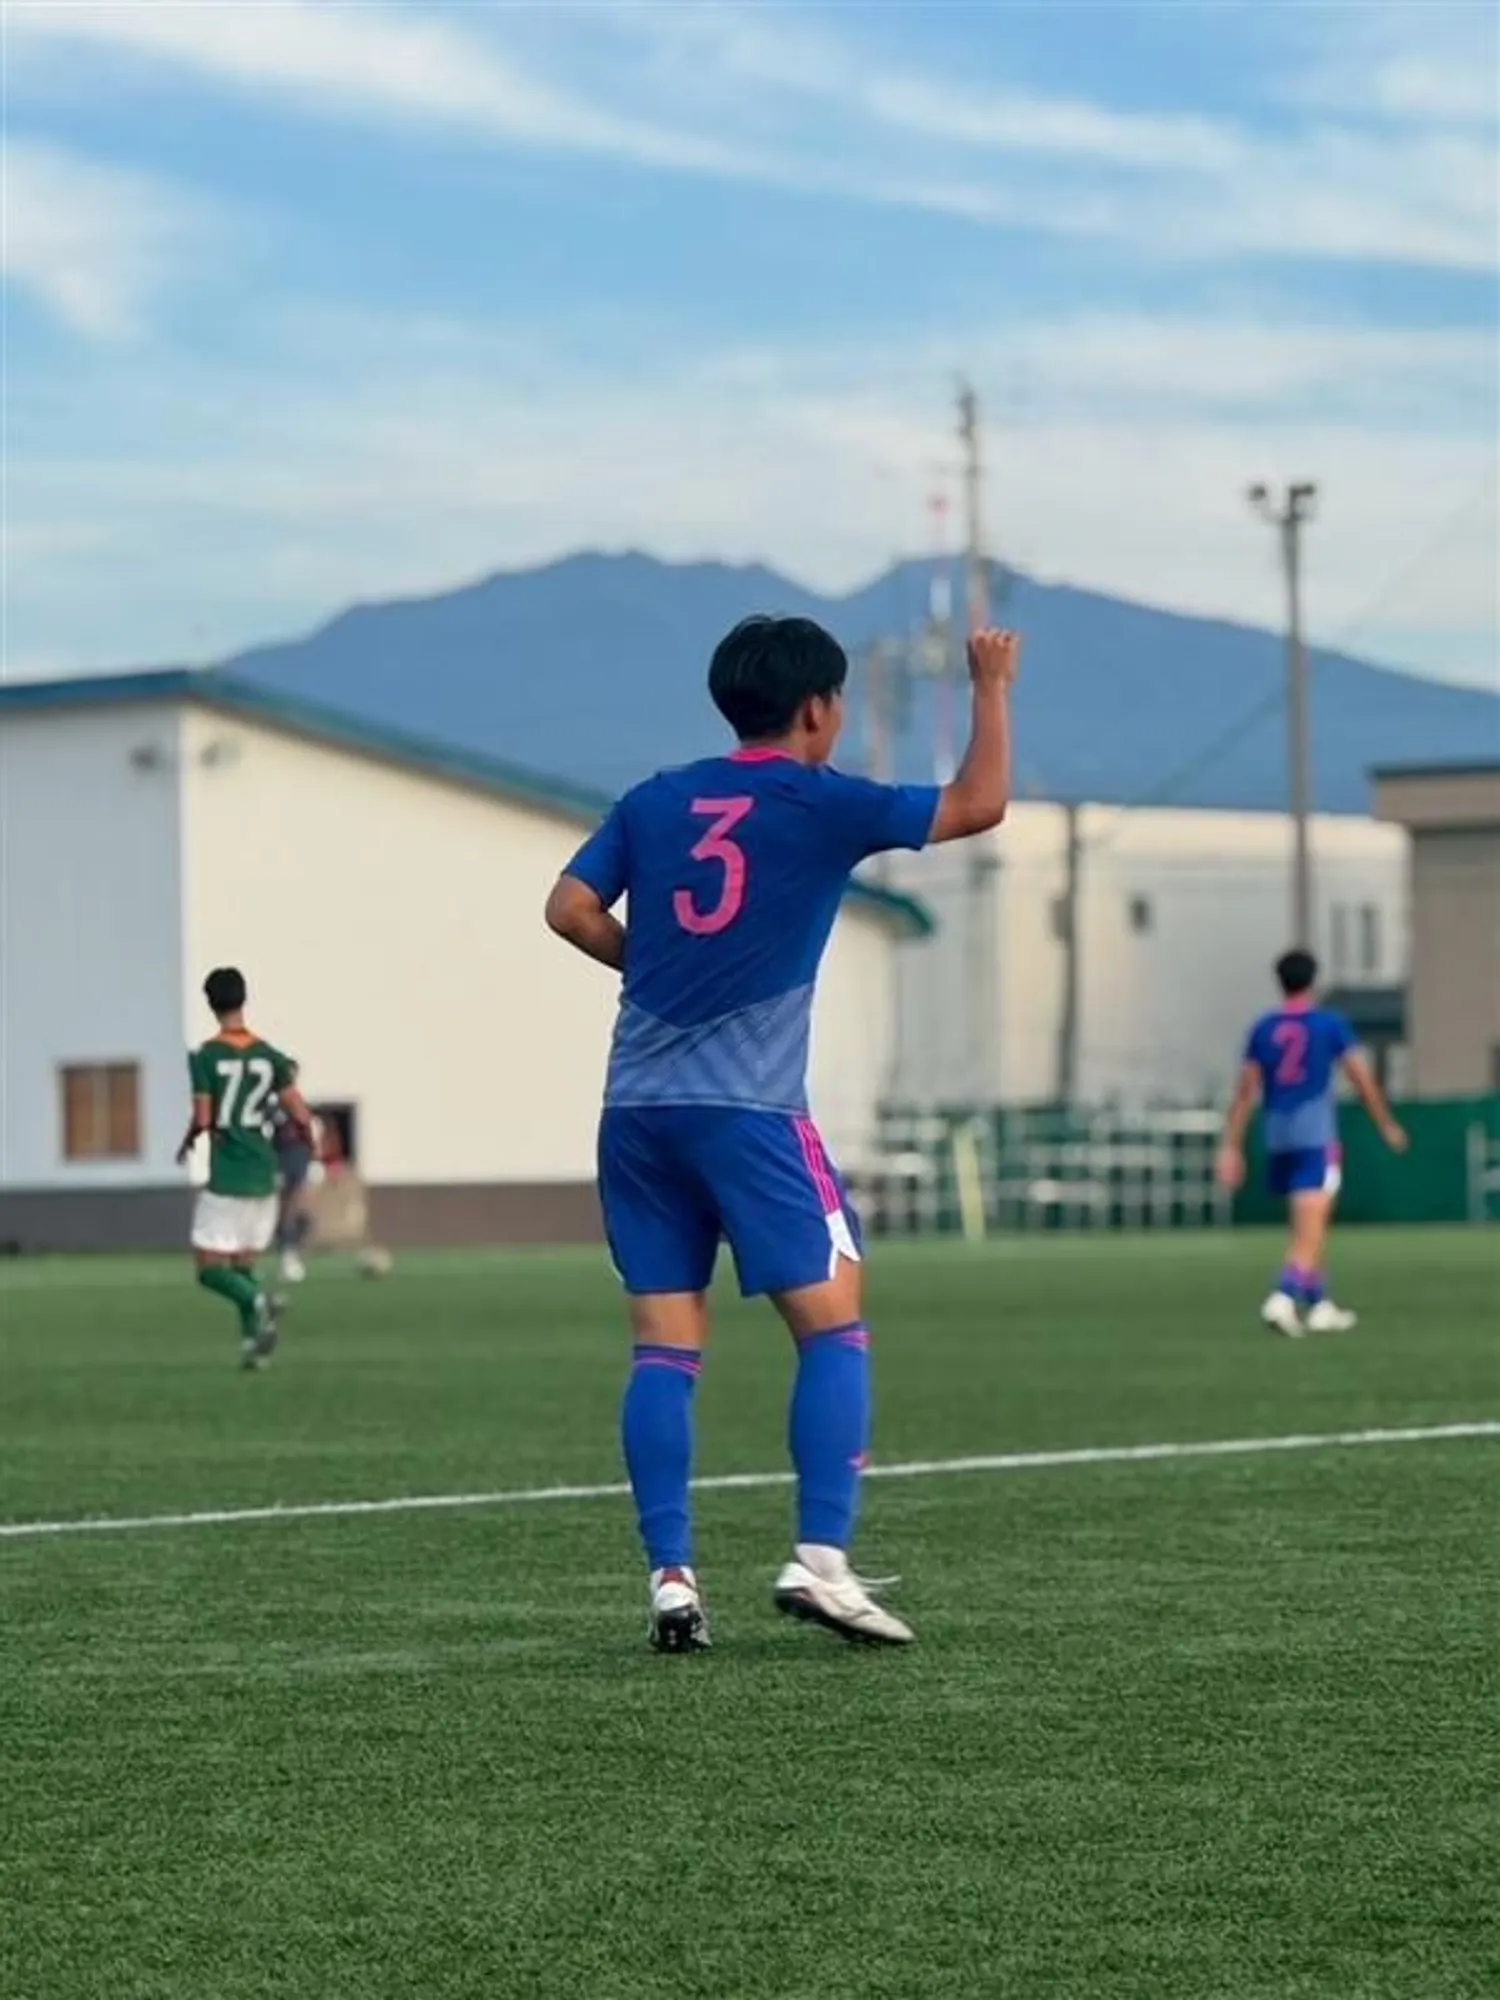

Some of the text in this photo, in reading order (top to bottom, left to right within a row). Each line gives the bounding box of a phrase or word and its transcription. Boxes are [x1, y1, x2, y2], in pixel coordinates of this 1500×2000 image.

[674, 797, 755, 935] 3
[1273, 1021, 1309, 1085] 2
[216, 1058, 273, 1128] 72
